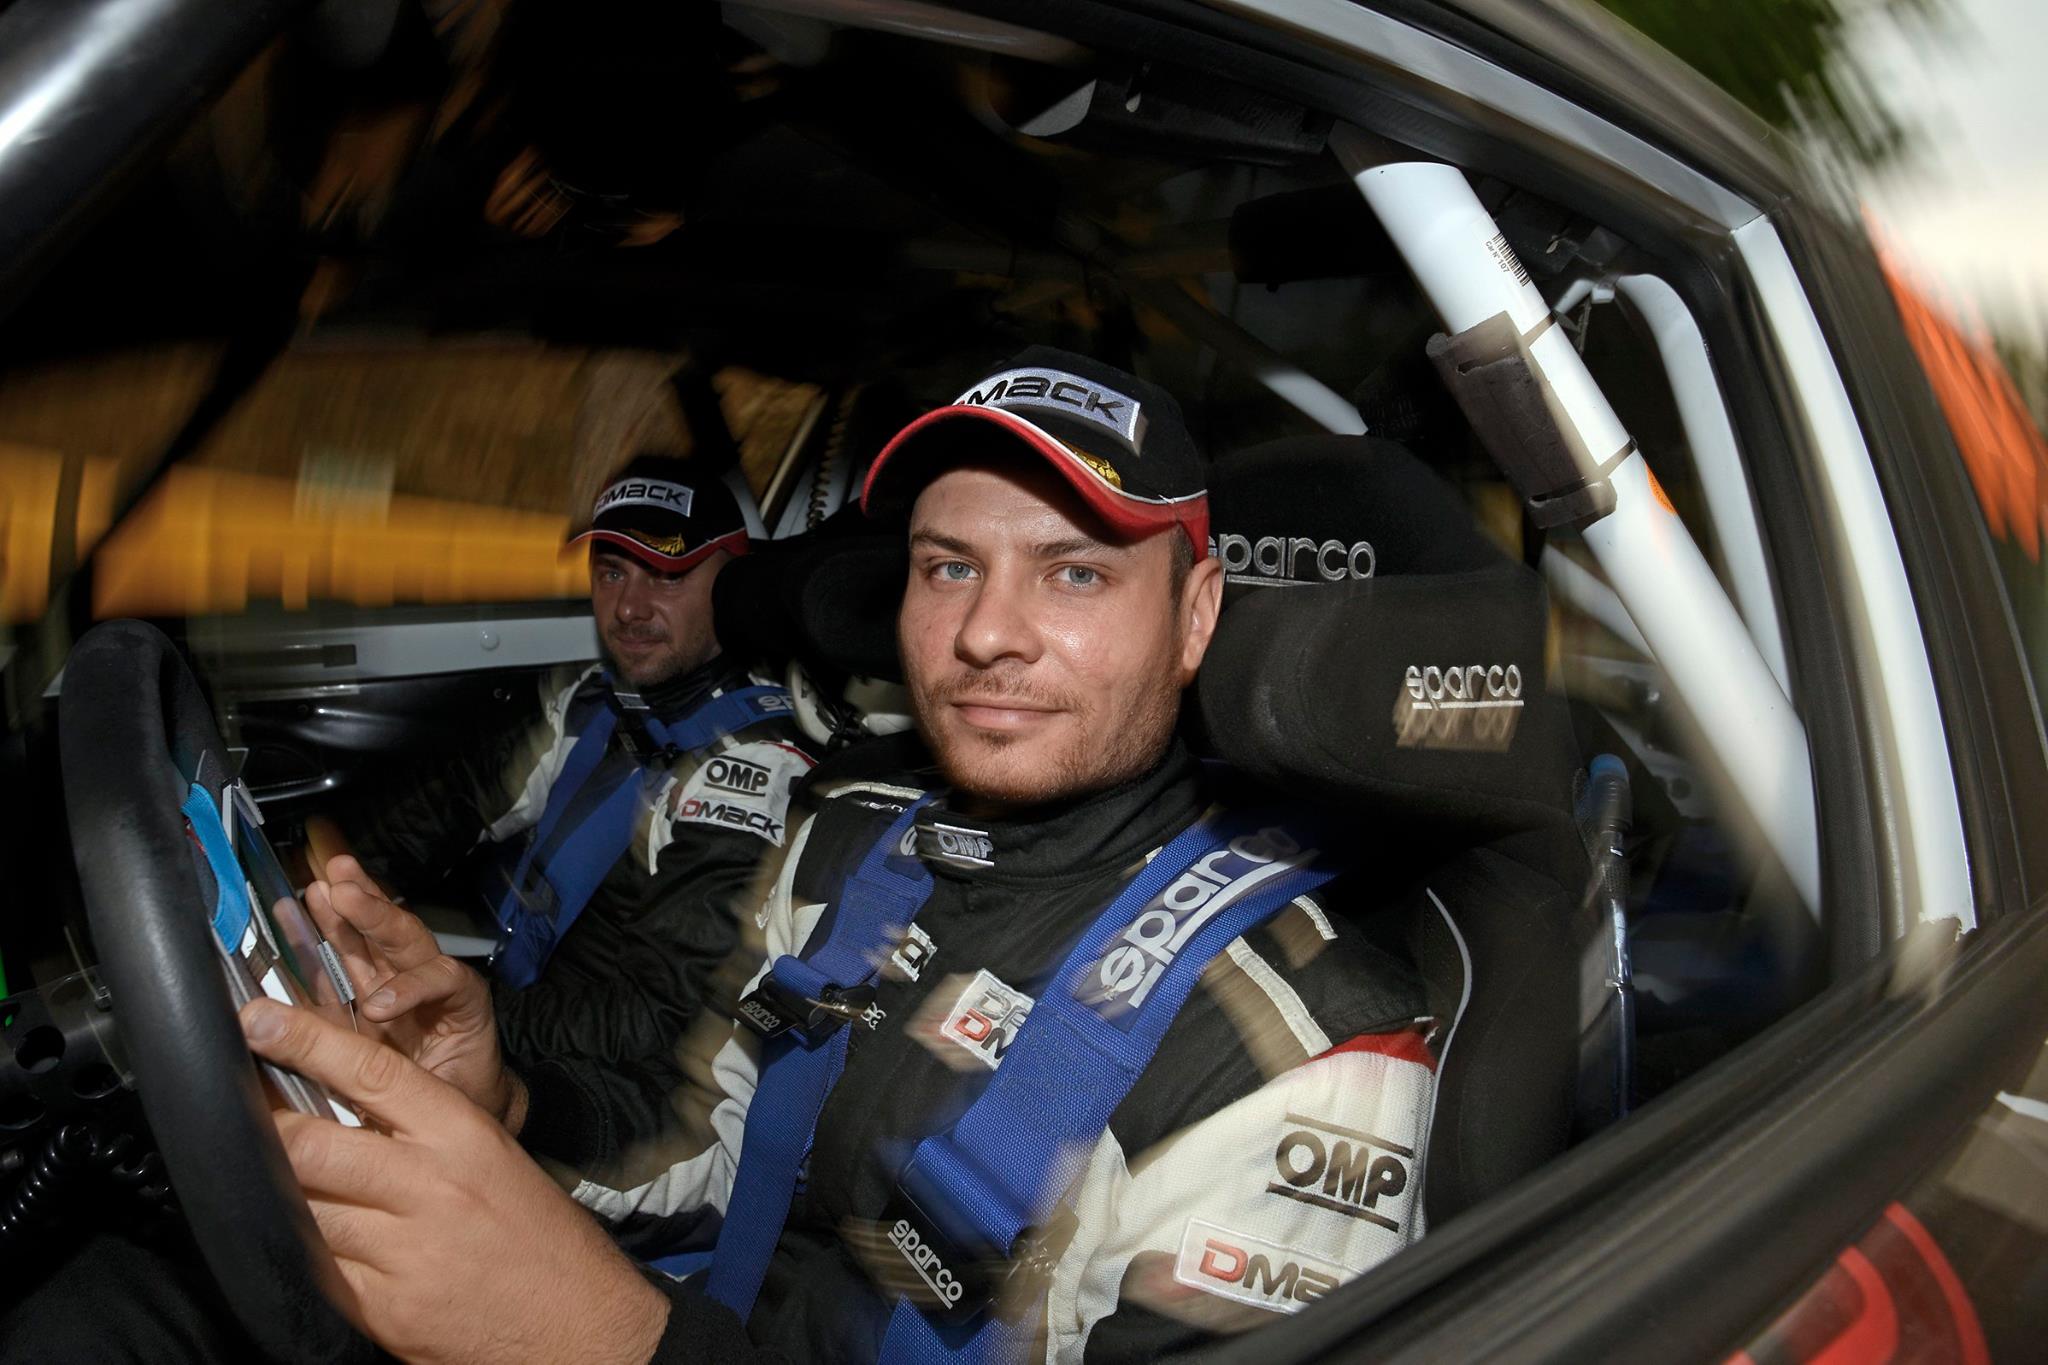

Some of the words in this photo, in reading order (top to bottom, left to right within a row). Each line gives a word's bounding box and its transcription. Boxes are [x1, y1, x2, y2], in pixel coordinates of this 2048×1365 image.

[1486, 240, 1494, 251] Car
[1498, 259, 1510, 273] 107
[955, 376, 1124, 423] MACK
[1406, 664, 1522, 711] sparco
[706, 759, 769, 792] OMP
[937, 831, 994, 859] OMP
[1100, 827, 1300, 998] sparco
[744, 1001, 781, 1029] sparco
[1275, 1131, 1408, 1209] OMP
[893, 1219, 964, 1302] sparco
